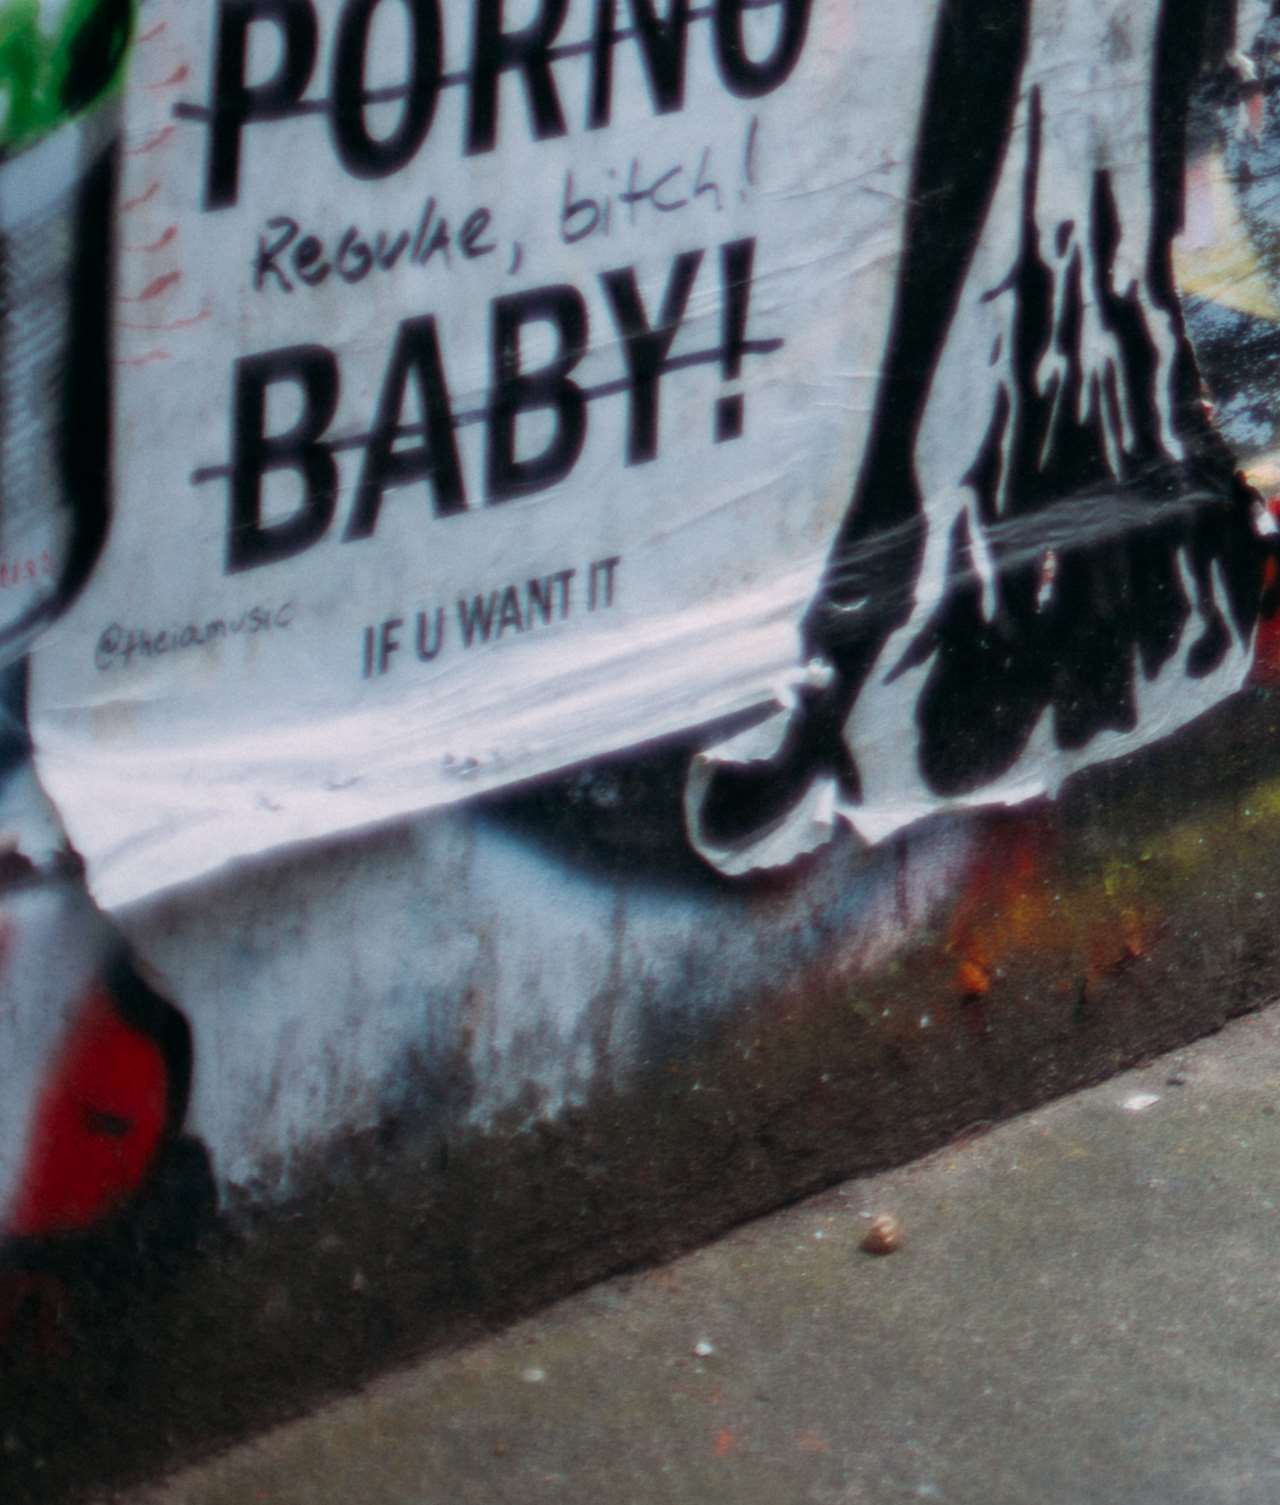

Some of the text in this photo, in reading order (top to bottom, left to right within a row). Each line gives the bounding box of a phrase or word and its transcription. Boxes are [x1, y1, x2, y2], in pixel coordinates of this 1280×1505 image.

[559, 114, 759, 246] bitch!
[223, 235, 758, 576] BABY!
[361, 554, 622, 680] IF U WANT IT
